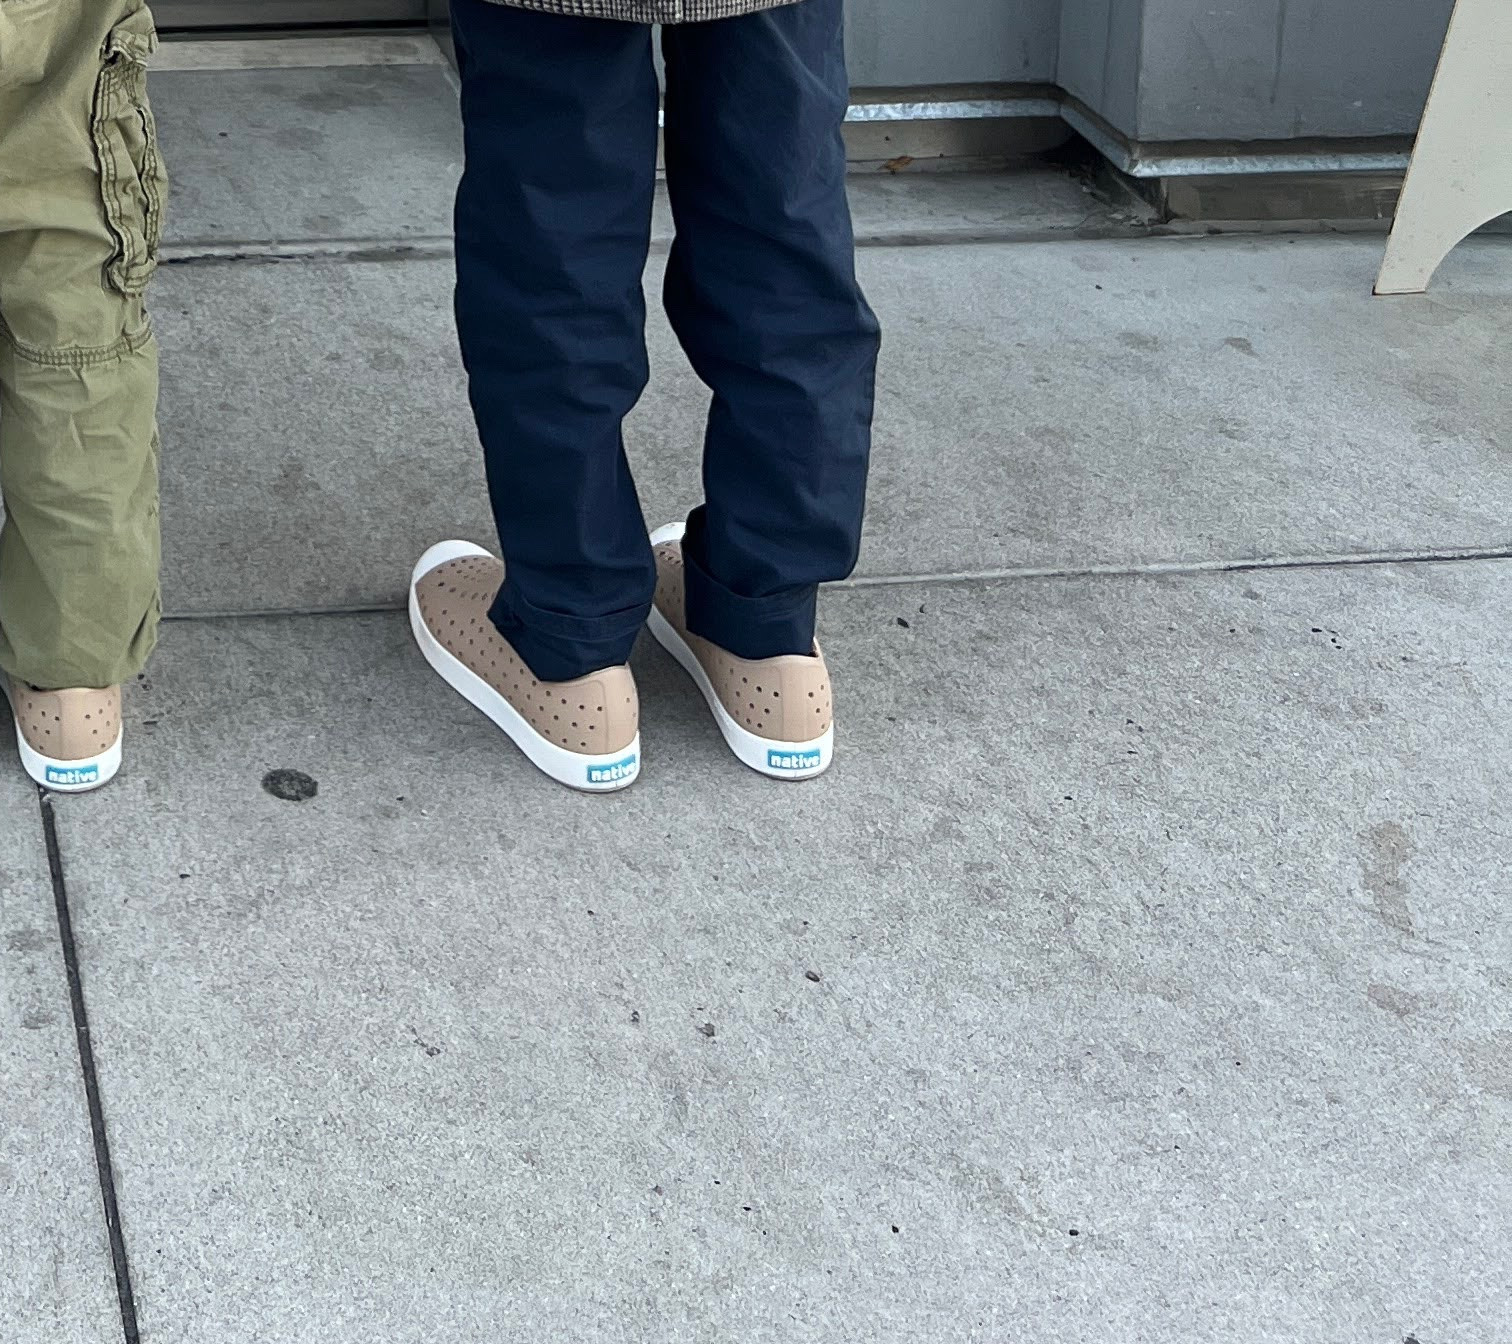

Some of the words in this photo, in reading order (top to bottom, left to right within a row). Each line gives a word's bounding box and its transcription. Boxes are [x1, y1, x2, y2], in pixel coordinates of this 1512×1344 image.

[770, 753, 820, 768] native
[49, 768, 98, 784] native
[590, 762, 637, 783] native
